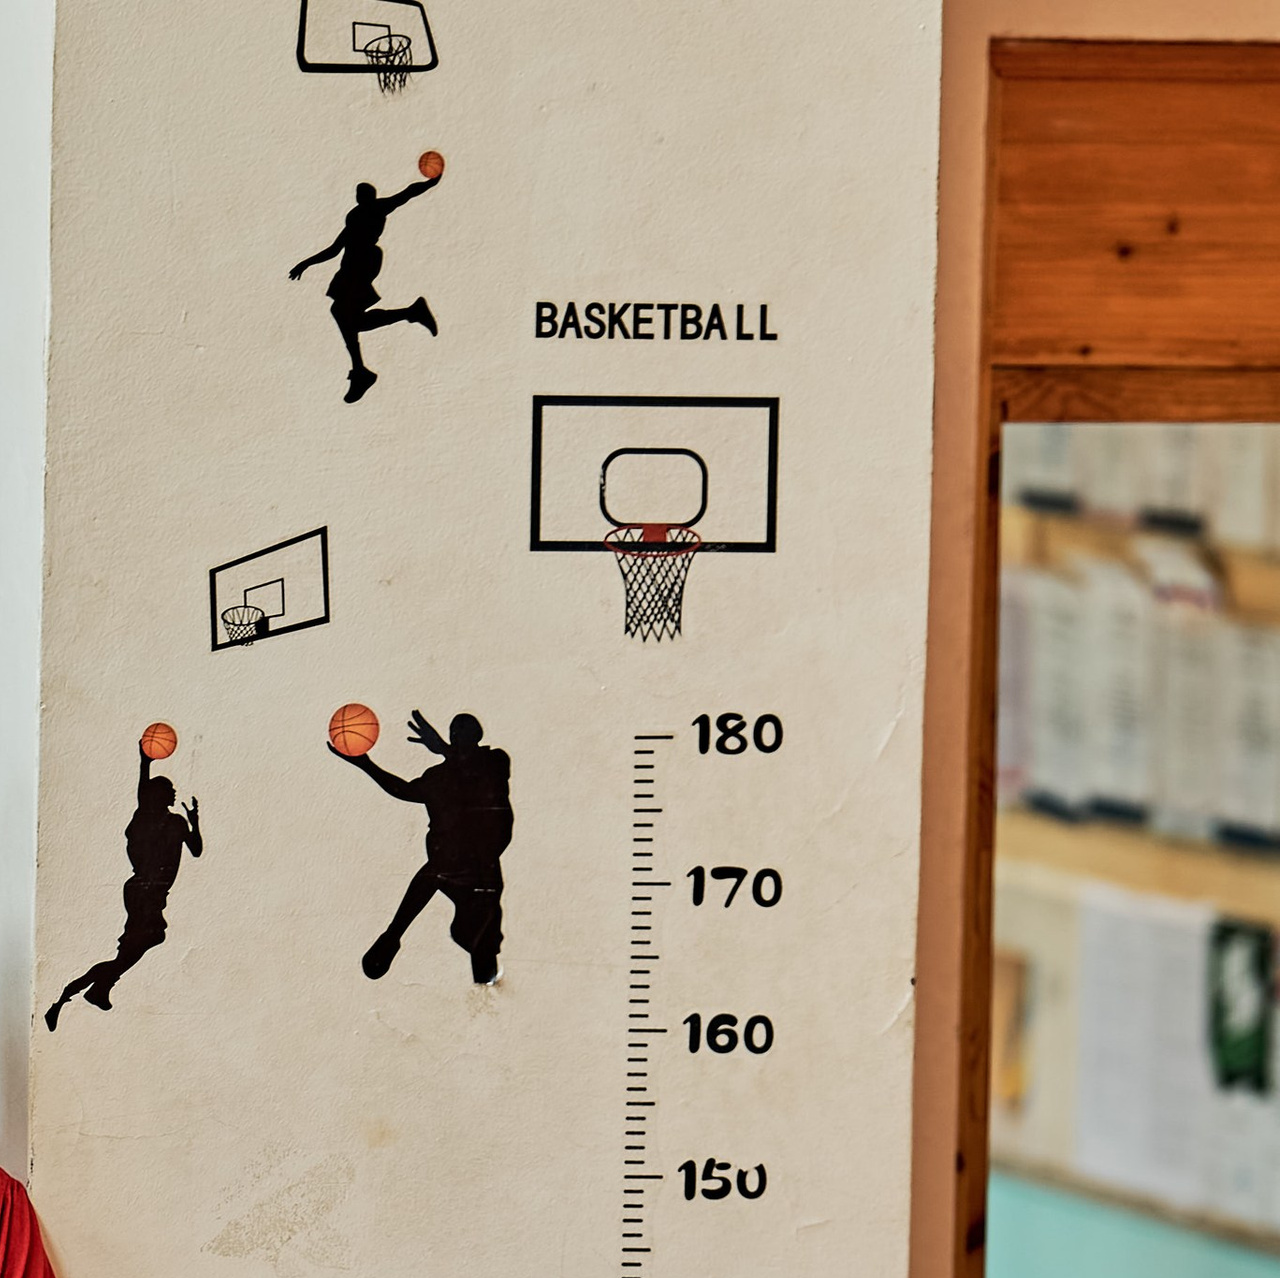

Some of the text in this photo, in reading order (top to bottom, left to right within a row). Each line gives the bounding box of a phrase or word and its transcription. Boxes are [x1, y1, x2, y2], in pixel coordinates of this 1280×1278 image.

[535, 301, 778, 341] BASKETBALL
[691, 712, 784, 755] 180
[687, 865, 783, 908] 170
[682, 1012, 774, 1055] 160
[677, 1157, 767, 1201] 150
